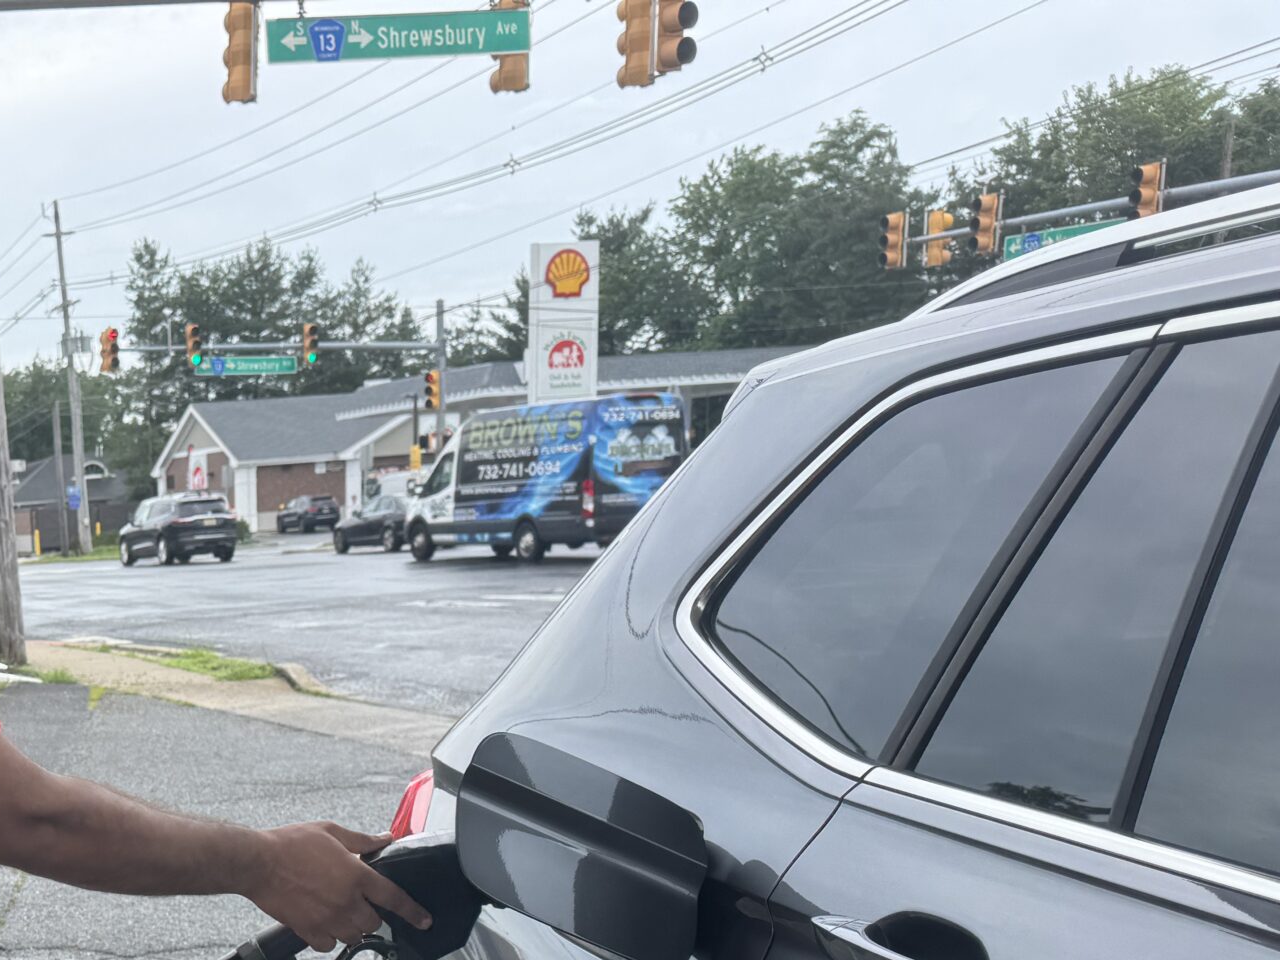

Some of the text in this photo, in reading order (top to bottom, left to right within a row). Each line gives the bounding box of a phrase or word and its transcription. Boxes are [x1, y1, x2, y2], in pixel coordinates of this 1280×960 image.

[296, 22, 304, 36] S
[351, 19, 359, 34] N
[377, 21, 518, 49] Shrewsbury Ave
[319, 34, 336, 51] 13
[468, 410, 584, 450] BROWN'S
[496, 446, 532, 459] COOLING
[540, 441, 584, 455] PLUMBING
[477, 460, 561, 480] 732-741-0694
